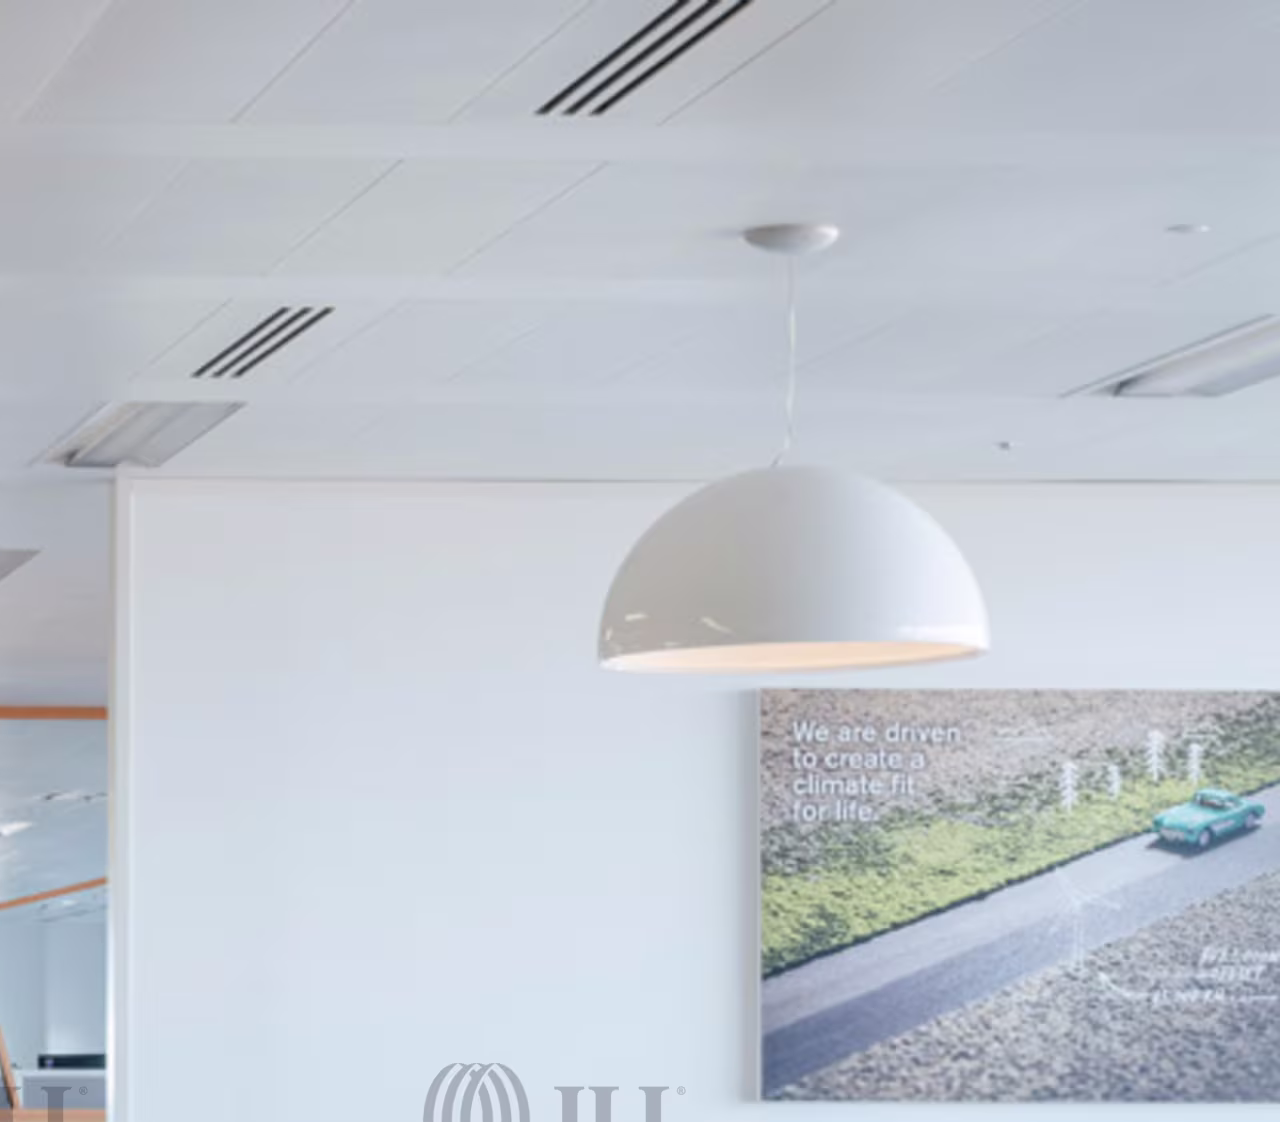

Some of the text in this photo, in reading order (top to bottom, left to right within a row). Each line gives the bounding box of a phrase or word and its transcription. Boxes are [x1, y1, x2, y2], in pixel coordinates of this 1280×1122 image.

[793, 721, 961, 742] We are driven
[793, 749, 925, 769] to create a
[793, 774, 915, 795] climate fit
[793, 801, 830, 822] for
